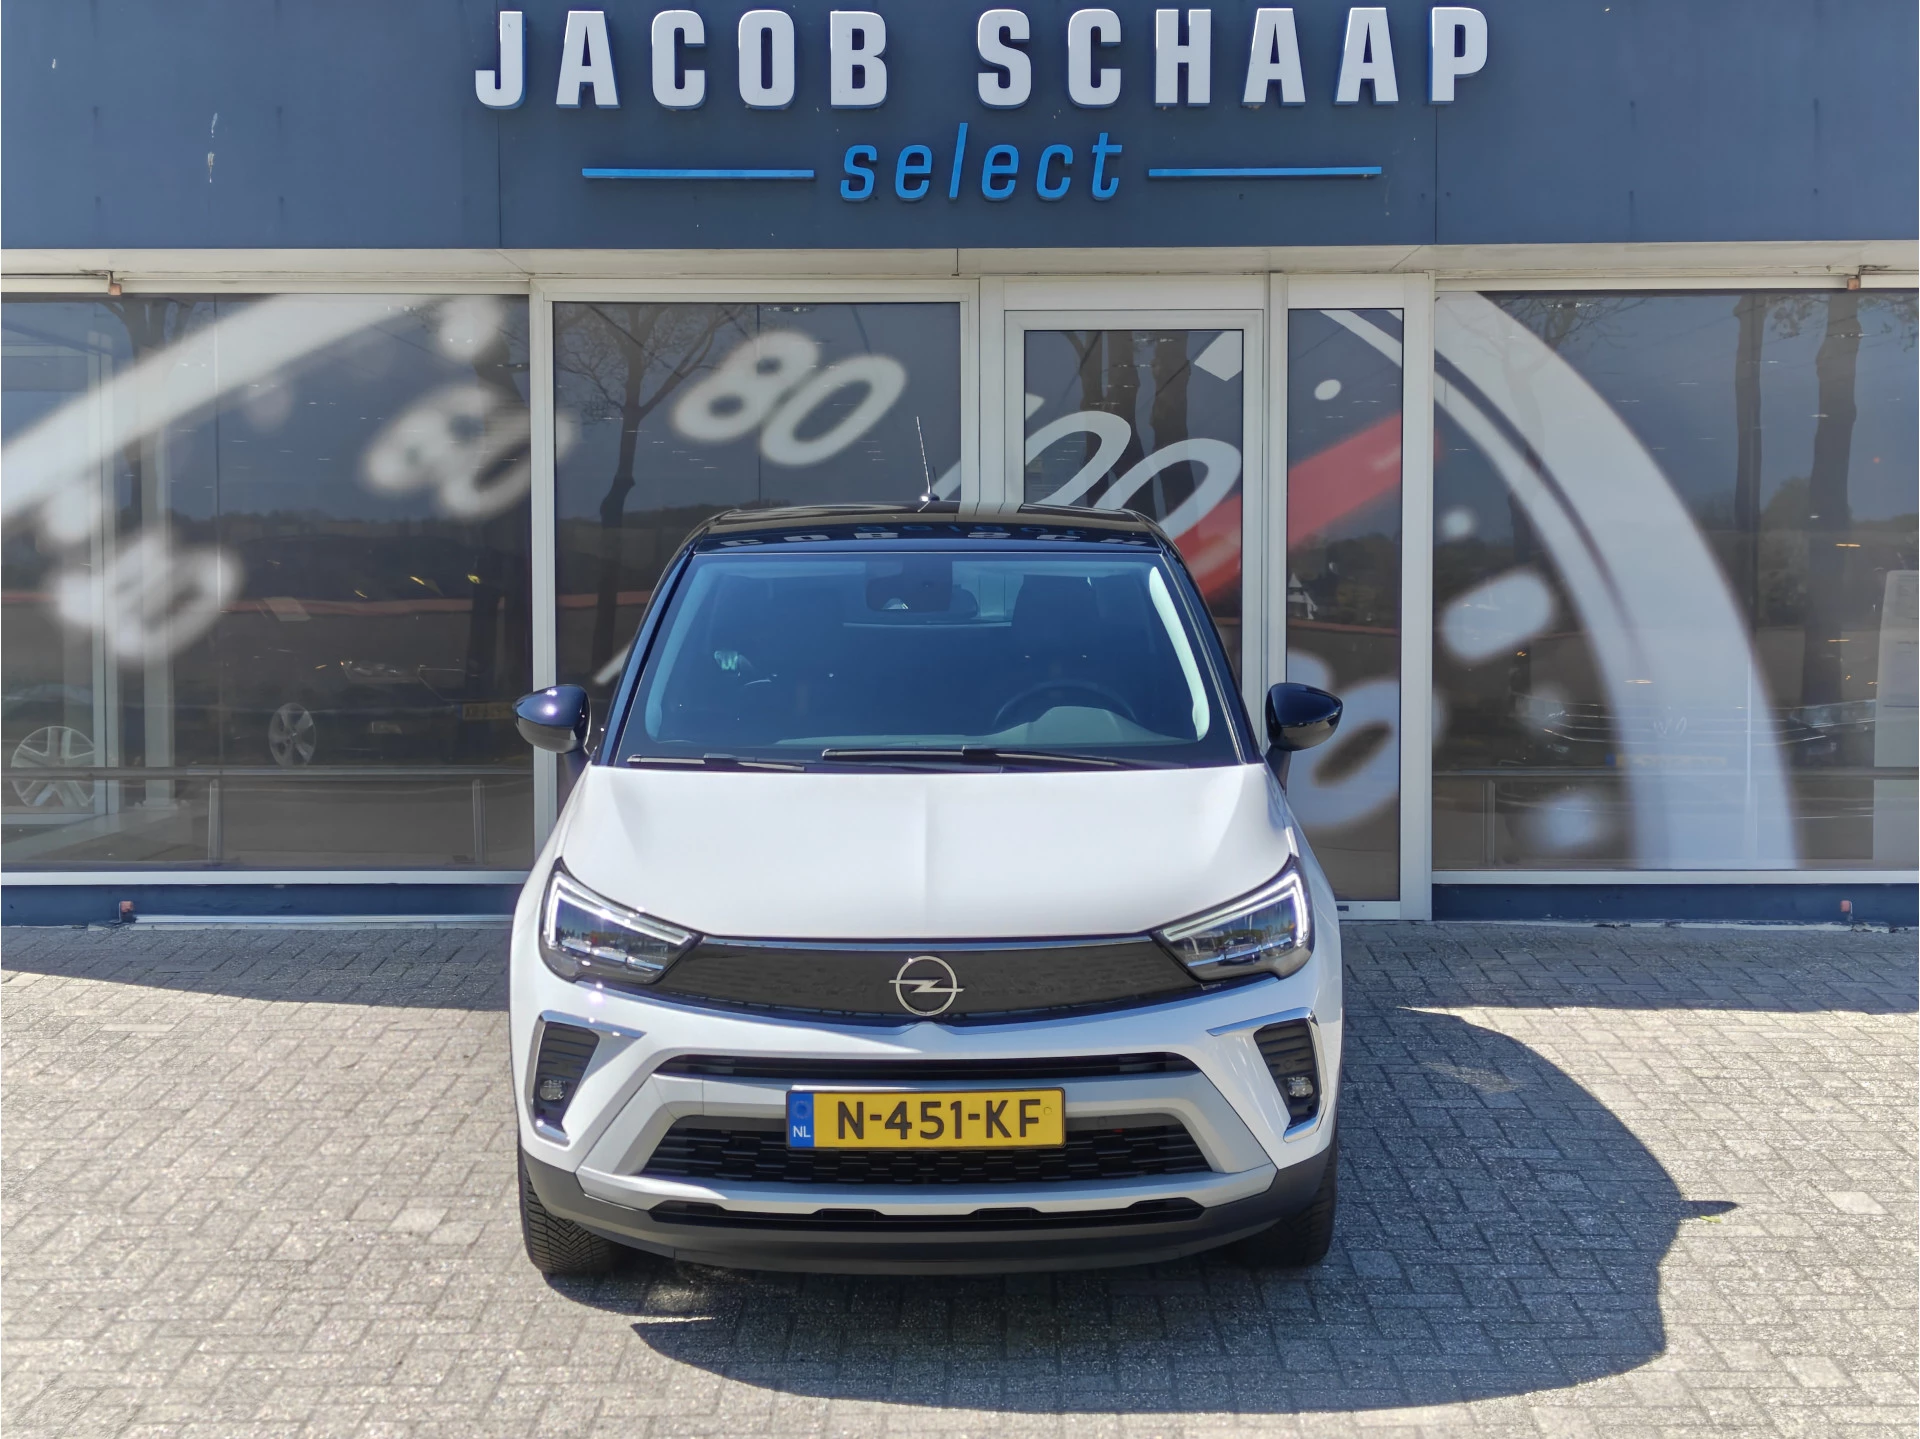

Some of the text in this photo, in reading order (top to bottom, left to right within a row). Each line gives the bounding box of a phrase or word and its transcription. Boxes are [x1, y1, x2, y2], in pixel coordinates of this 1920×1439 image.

[475, 6, 1488, 109] JACOB SCHAAP
[839, 123, 1122, 201] select
[669, 330, 907, 467] 80
[792, 1125, 811, 1138] NL
[837, 1098, 1041, 1140] N-451-KF
